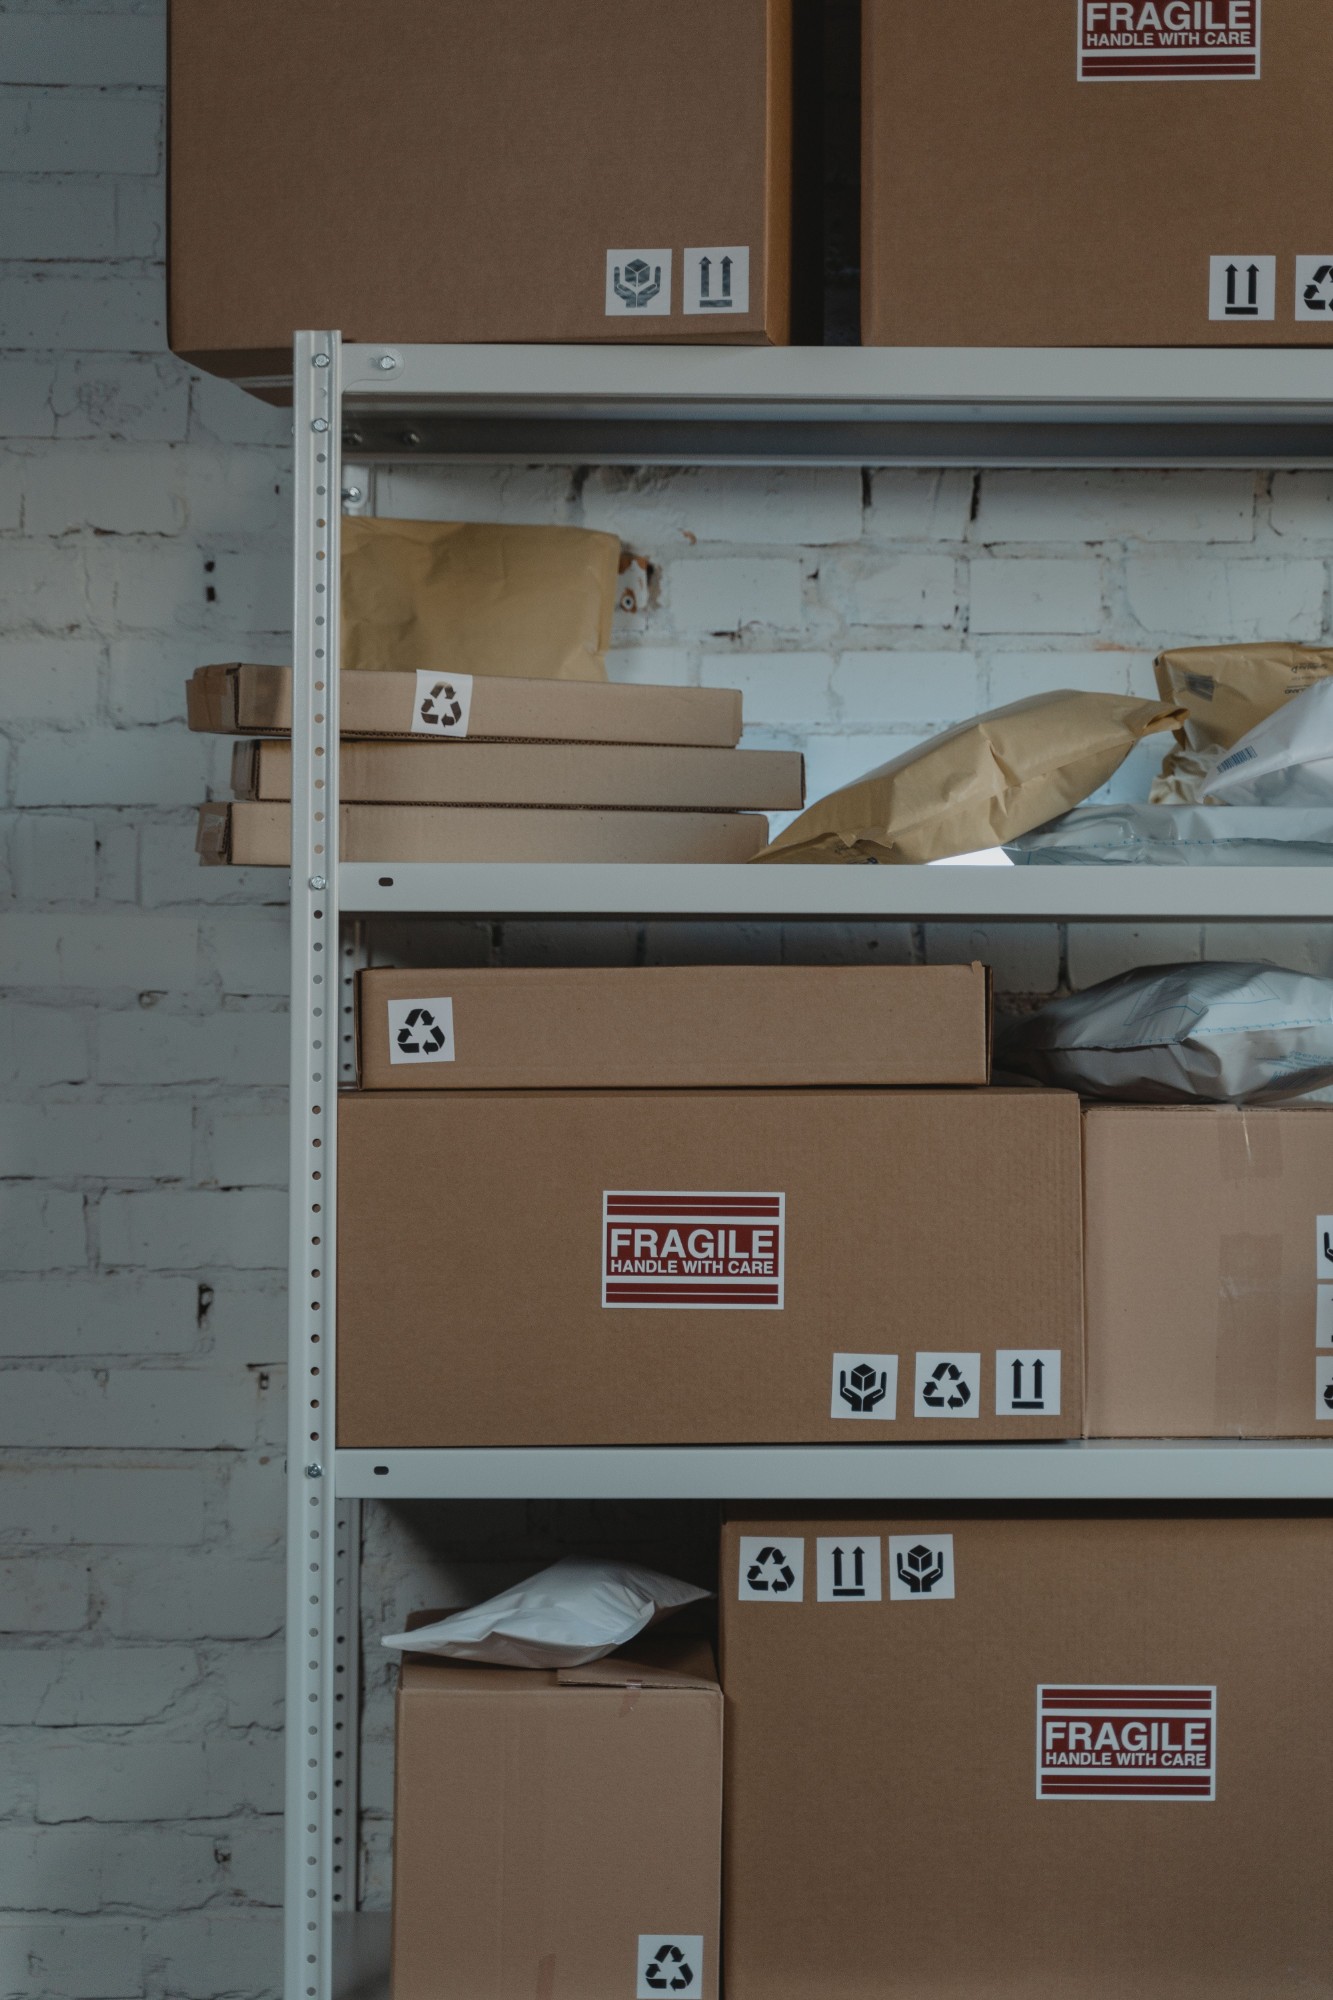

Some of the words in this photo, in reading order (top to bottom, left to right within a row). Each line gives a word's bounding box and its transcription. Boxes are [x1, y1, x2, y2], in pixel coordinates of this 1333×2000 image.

[1086, 1, 1251, 31] FRAGILE
[1086, 32, 1154, 46] HANDLE
[1158, 32, 1200, 46] WITH
[1204, 31, 1251, 45] CARE
[610, 1228, 774, 1260] FRAGILE
[610, 1259, 678, 1273] HANDLE
[682, 1260, 723, 1274] WITH
[728, 1260, 774, 1275] CARE
[1045, 1721, 1207, 1752] FRAGILE
[1045, 1752, 1112, 1766] HANDLE
[1115, 1752, 1157, 1766] WITH
[1160, 1753, 1206, 1766] CARE
